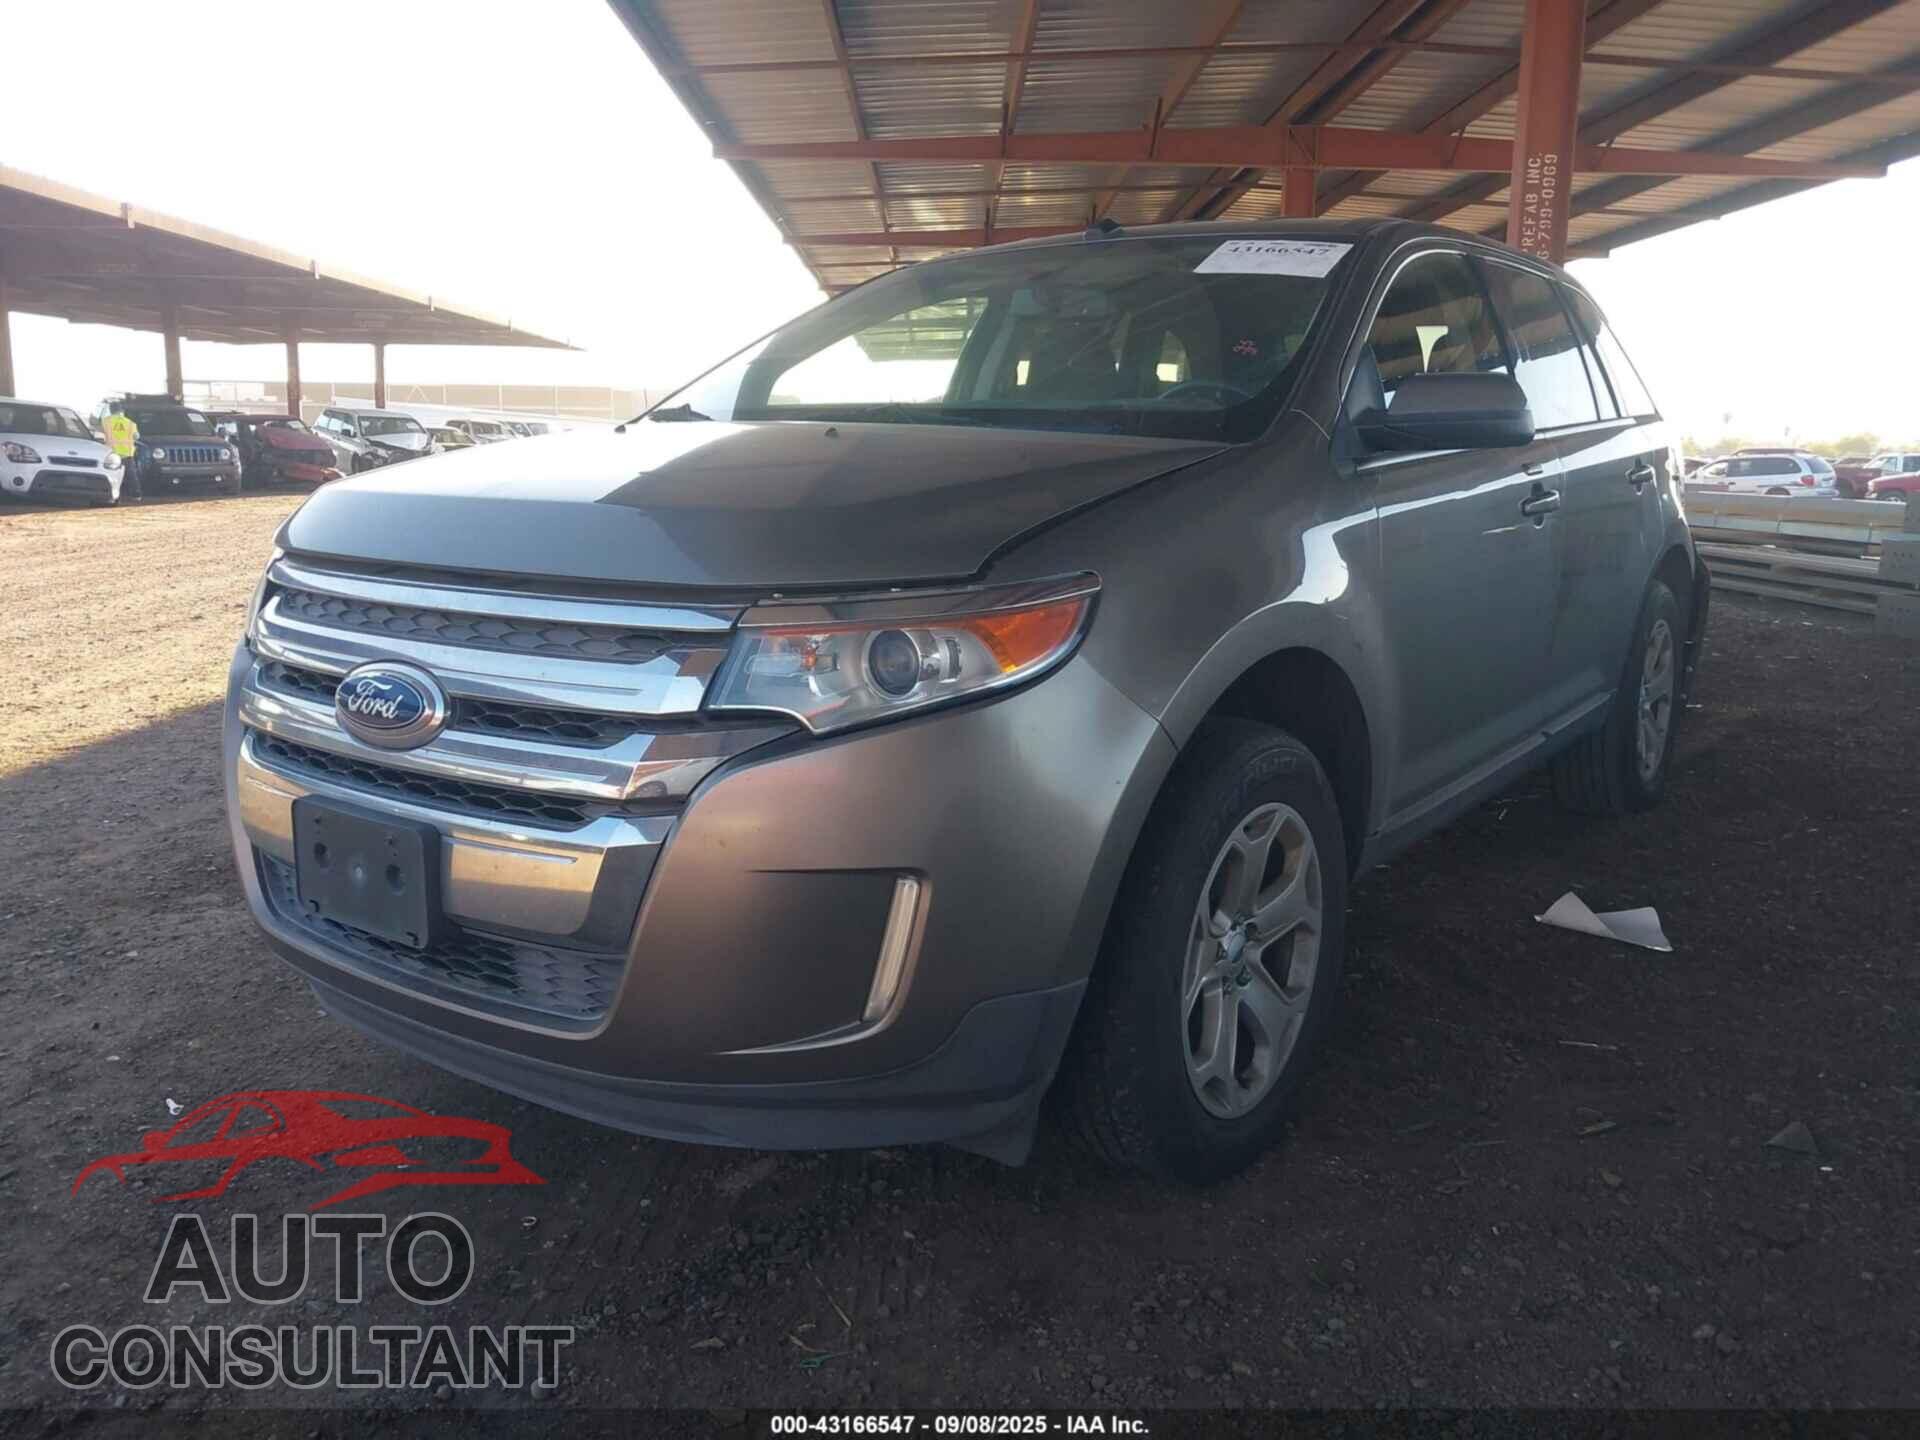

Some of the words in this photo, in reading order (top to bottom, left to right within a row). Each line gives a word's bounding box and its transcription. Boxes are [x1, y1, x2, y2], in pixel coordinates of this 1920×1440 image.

[1526, 152, 1543, 183] INC.
[1521, 193, 1539, 253] REFAB
[348, 679, 404, 719] Ford
